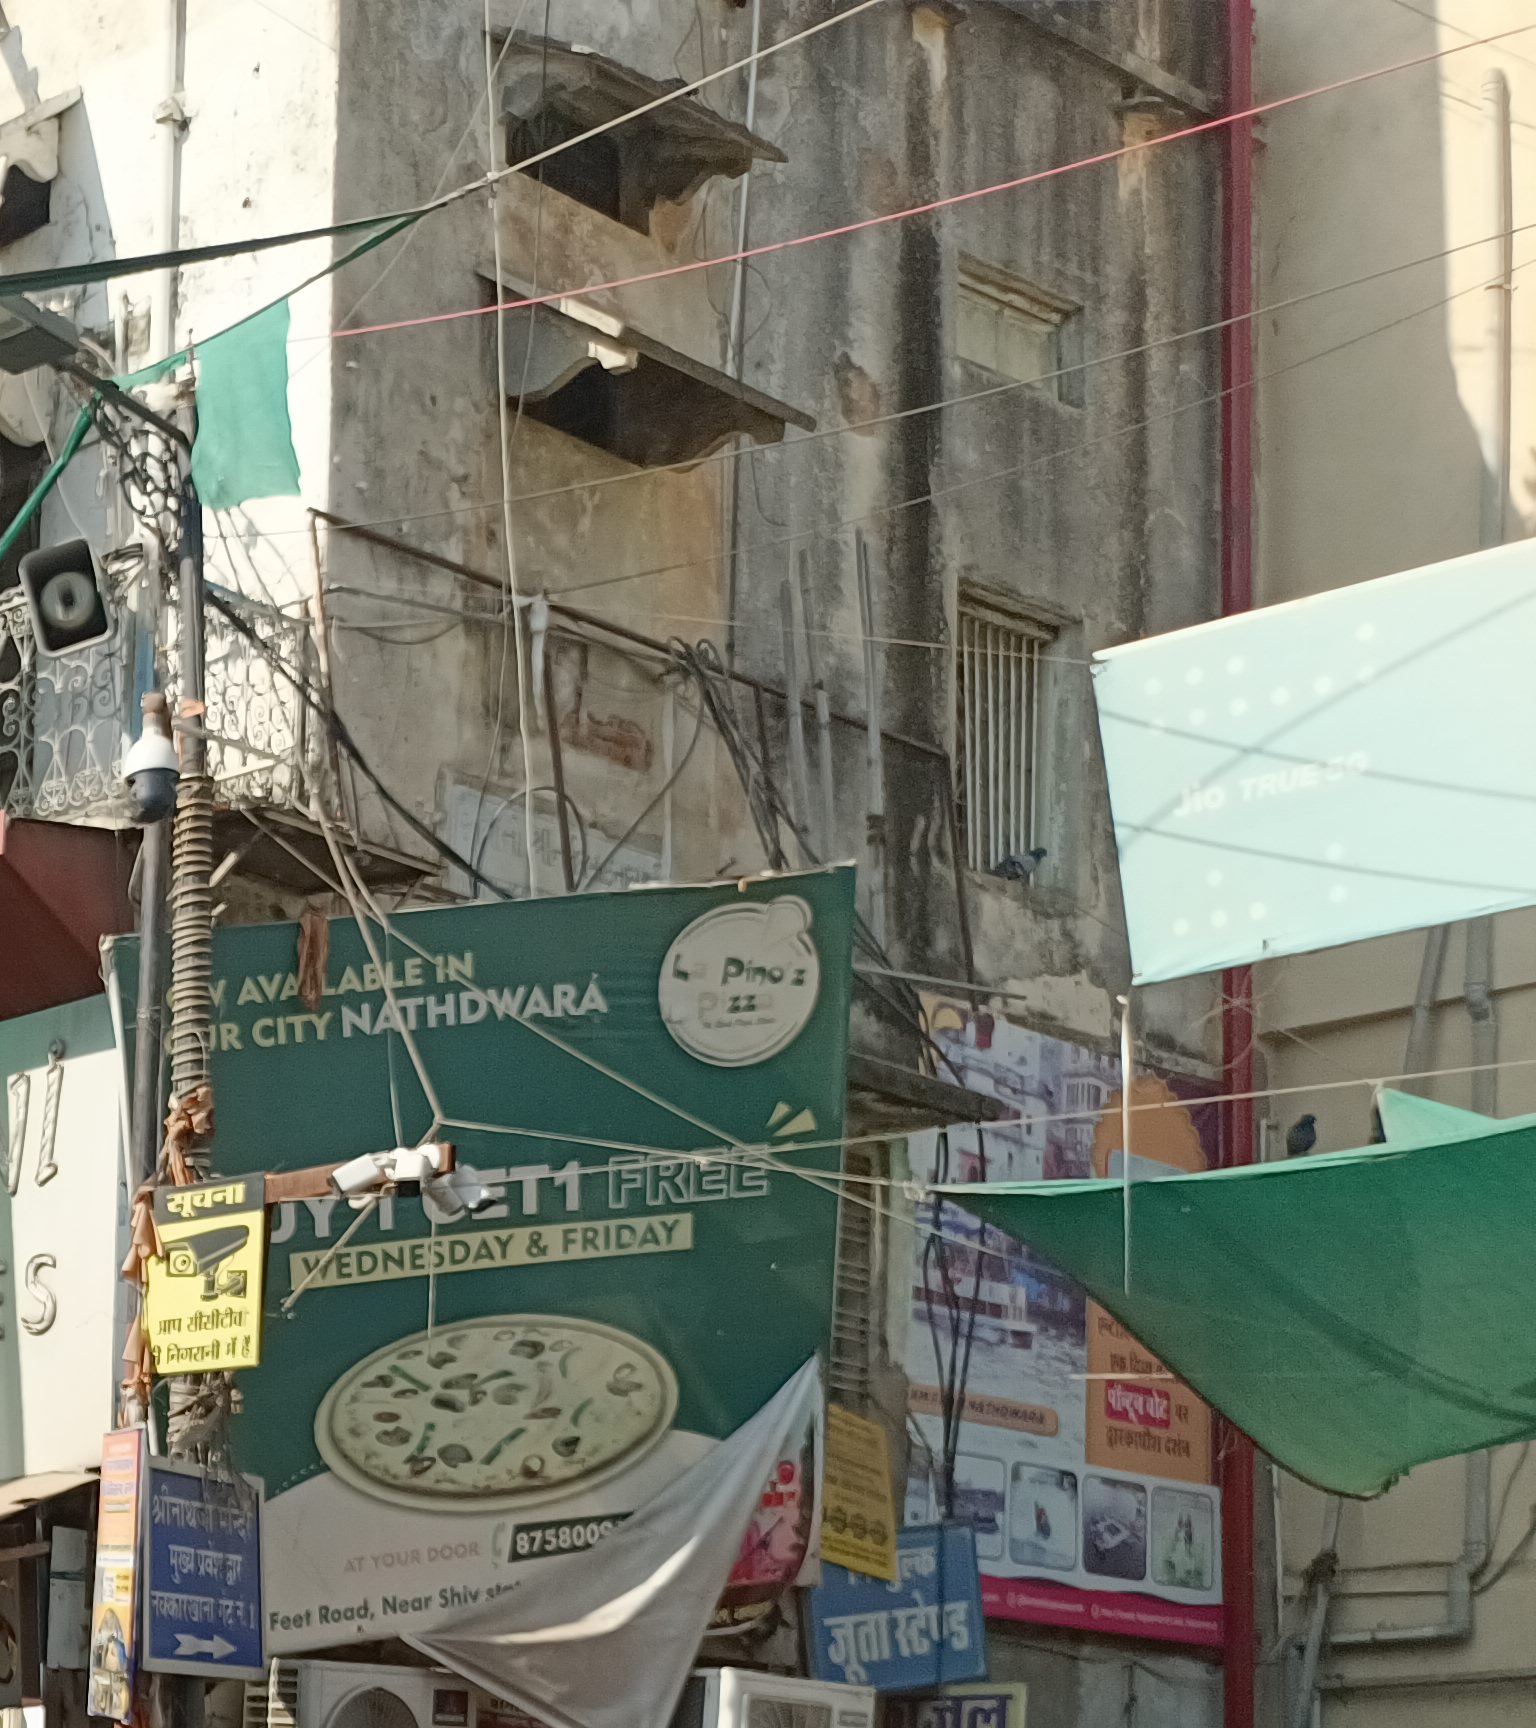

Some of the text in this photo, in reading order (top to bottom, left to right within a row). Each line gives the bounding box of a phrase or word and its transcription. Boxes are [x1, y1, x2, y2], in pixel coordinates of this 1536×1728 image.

[1239, 765, 1319, 803] TRUE
[237, 958, 425, 1006] AVALABLE
[435, 951, 475, 984] IN
[251, 1011, 333, 1048] CITY
[341, 980, 609, 1040] NATHDWARA
[166, 1184, 247, 1218] सूचना
[608, 1144, 772, 1211] FREE
[301, 1217, 681, 1282] WEDNESDAY & FRIDAY
[166, 1338, 221, 1365] निगरानी
[168, 1544, 195, 1585] मुख्य
[343, 1555, 365, 1574] AT
[371, 1550, 422, 1570] YOUR
[428, 1541, 481, 1562] DOOR
[269, 1608, 312, 1632] Feet
[318, 1598, 376, 1624] Road,
[382, 1594, 432, 1617] Near
[438, 1585, 479, 1609] Shiv
[823, 1609, 892, 1685] जूता
